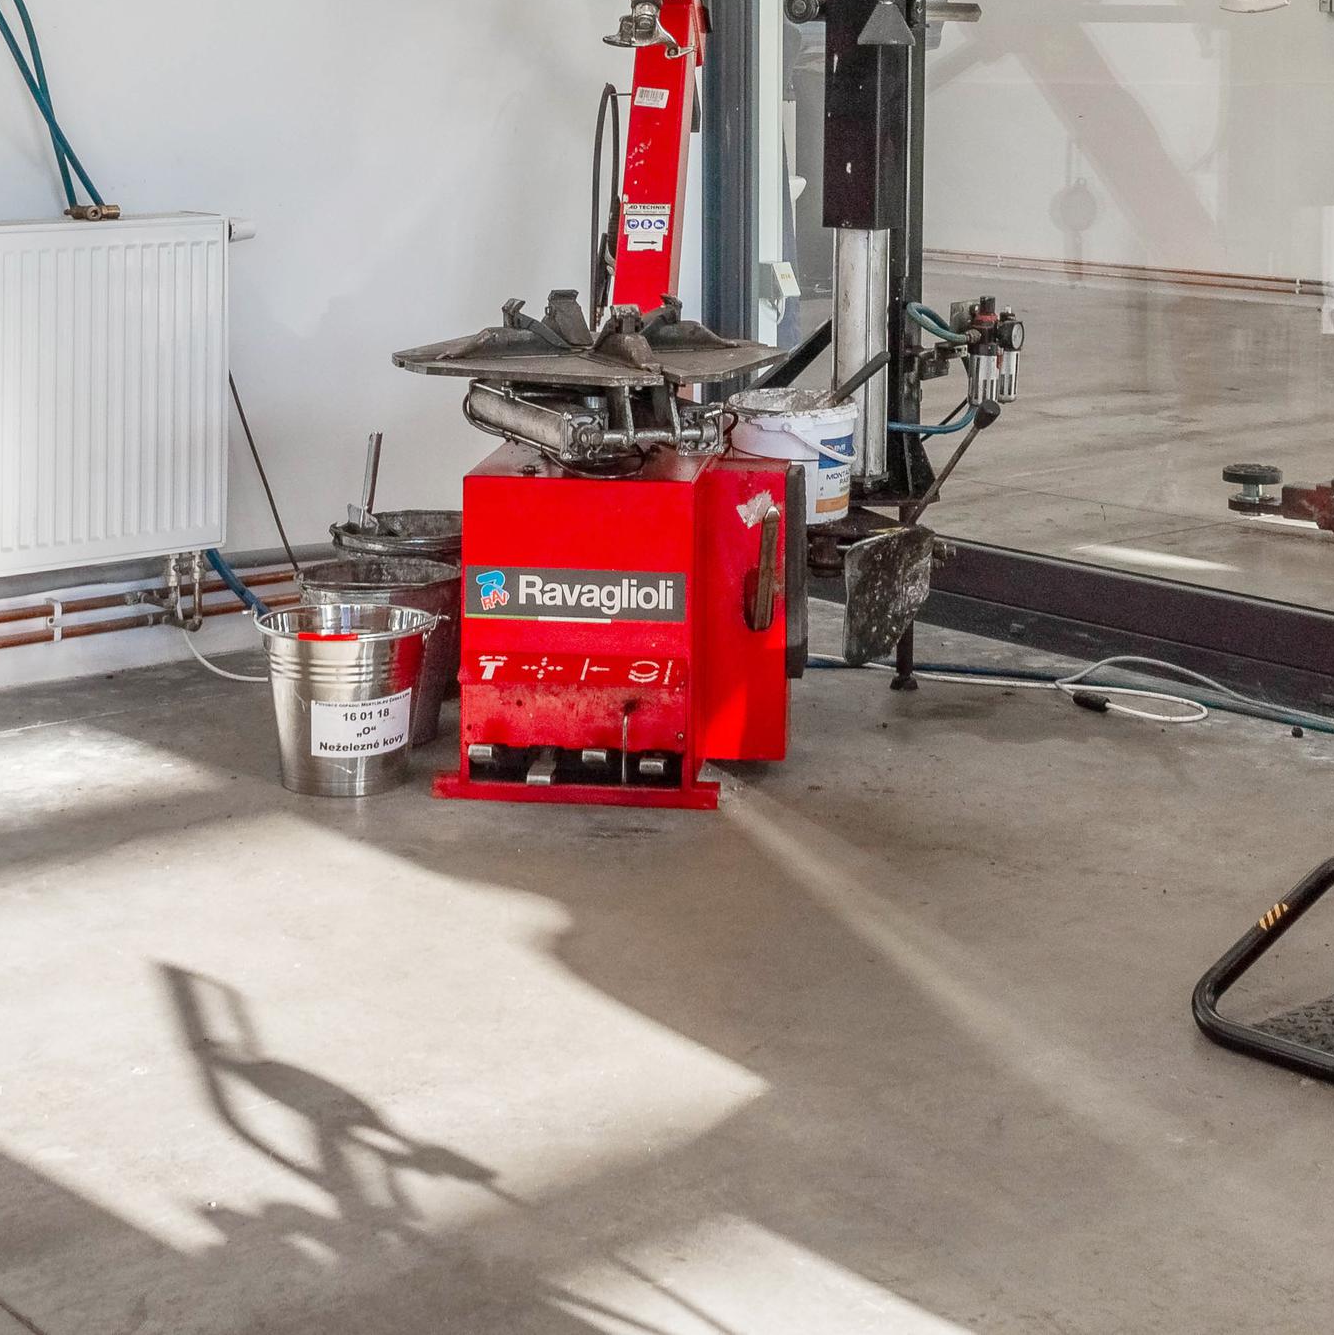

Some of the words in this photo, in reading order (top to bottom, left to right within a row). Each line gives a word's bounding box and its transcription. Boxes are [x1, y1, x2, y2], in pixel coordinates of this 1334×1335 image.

[518, 574, 674, 616] Ravaglioli
[343, 712, 357, 722] 16
[360, 711, 373, 721] 01
[377, 707, 390, 719] 18
[319, 739, 380, 752] Neželezné
[383, 732, 405, 747] kovy
